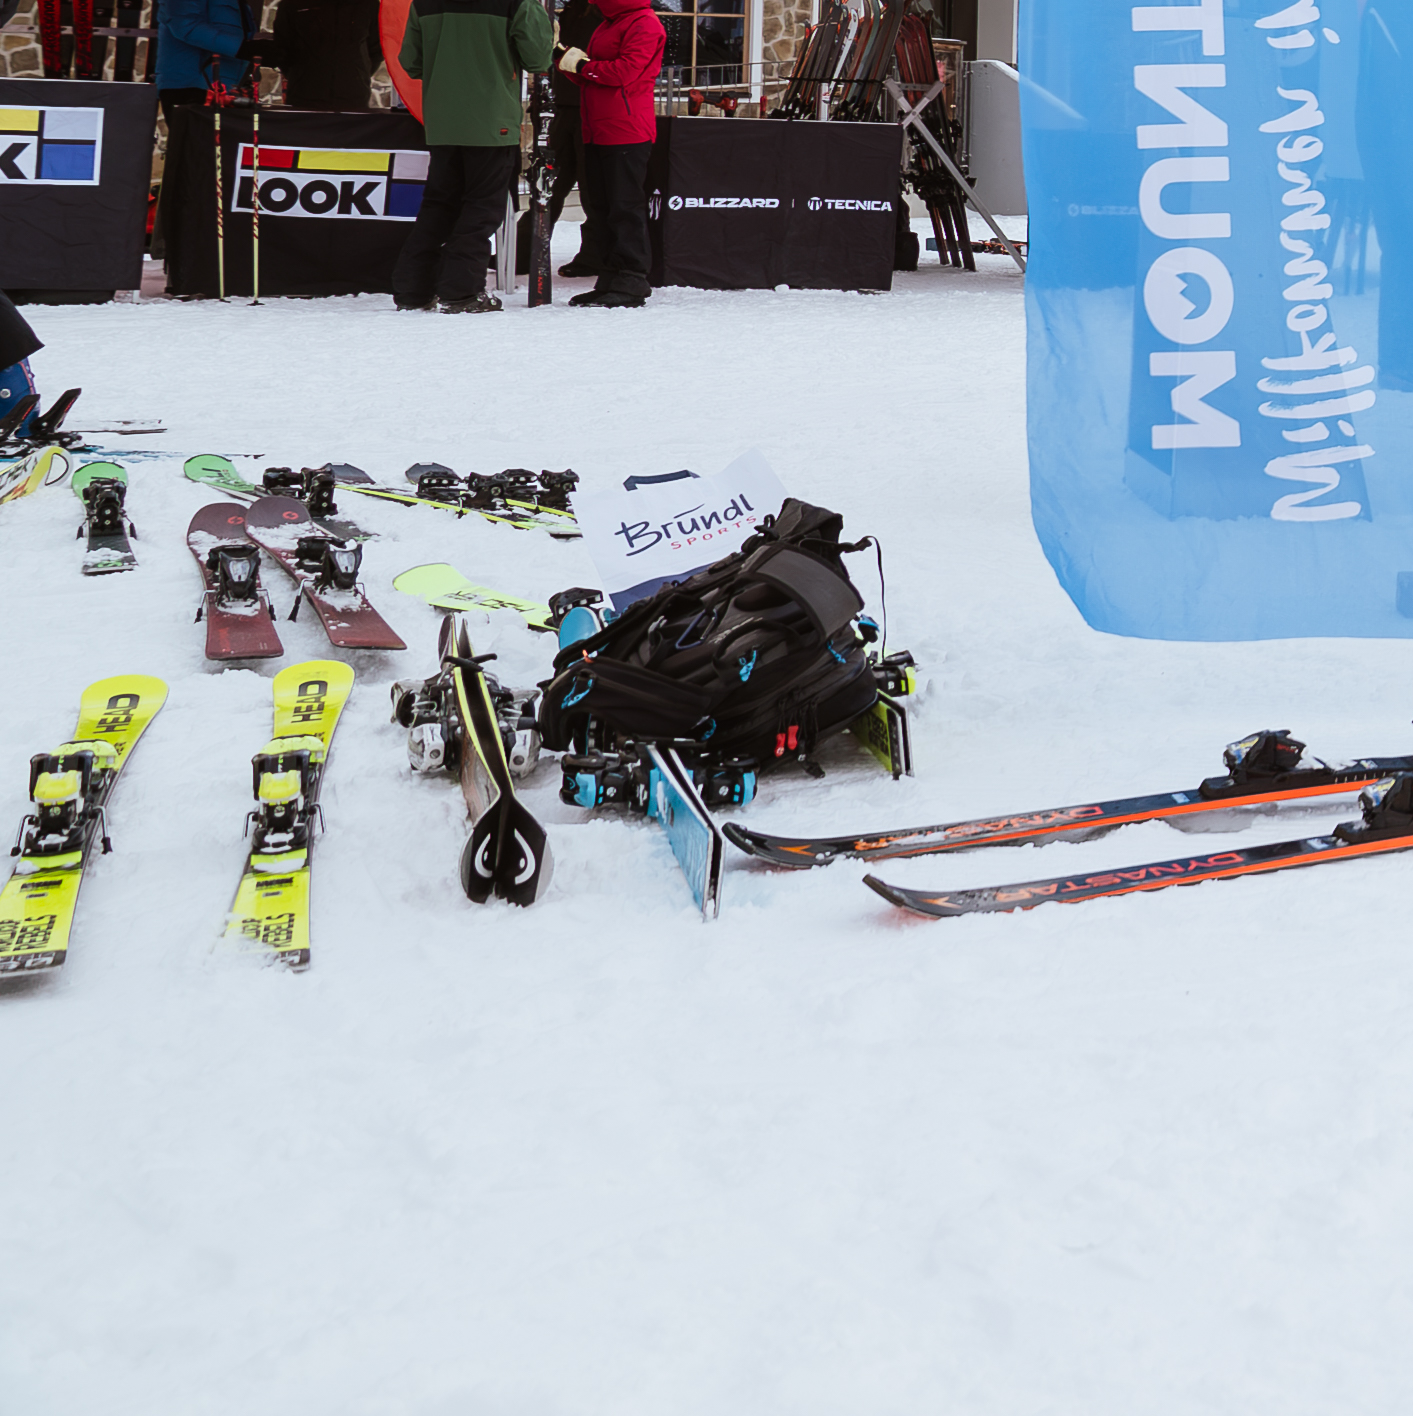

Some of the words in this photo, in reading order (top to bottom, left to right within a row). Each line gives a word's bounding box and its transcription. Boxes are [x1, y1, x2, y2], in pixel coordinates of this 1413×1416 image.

[238, 177, 384, 217] LOOK
[684, 196, 780, 210] BLIZZARD
[824, 197, 893, 213] TECNICA
[669, 514, 758, 550] SPORTS
[92, 693, 141, 735] HEAD
[290, 679, 329, 725] HEAD
[996, 850, 1245, 904] DYNASTAR
